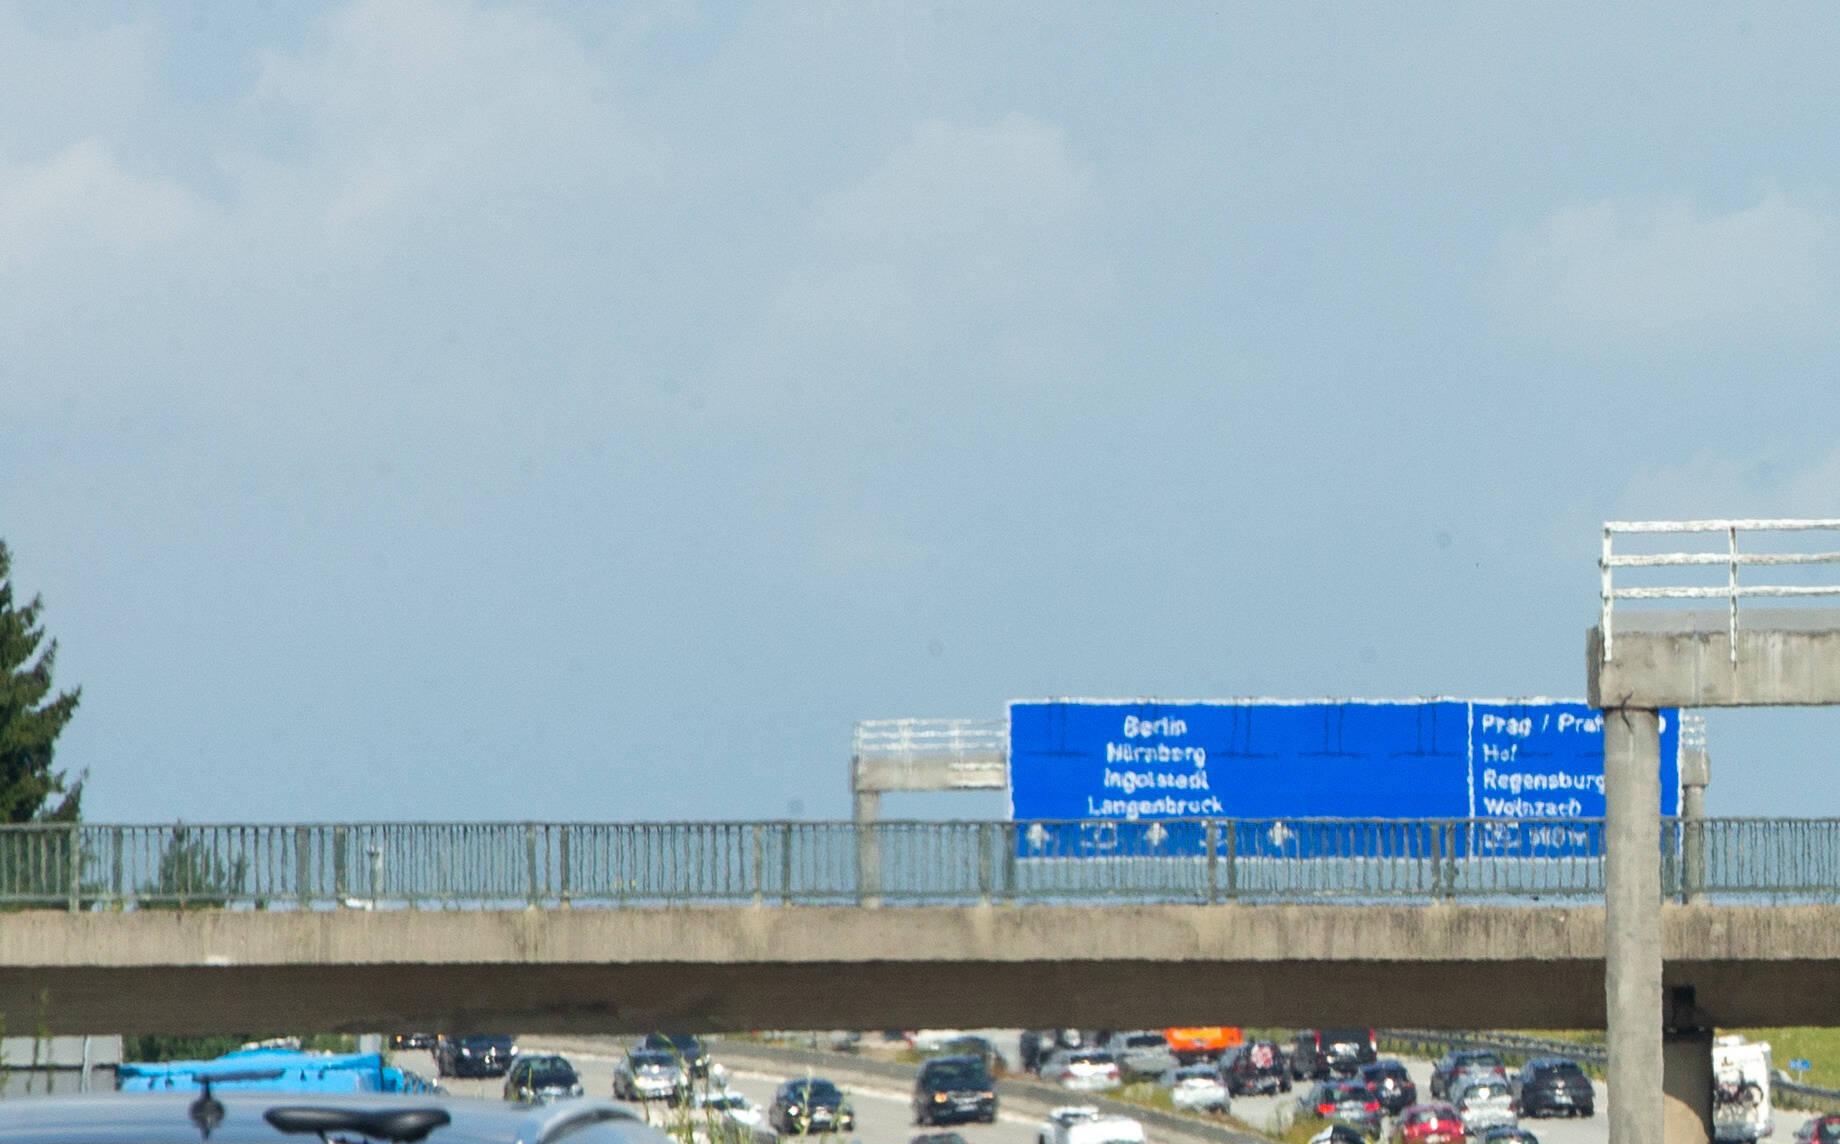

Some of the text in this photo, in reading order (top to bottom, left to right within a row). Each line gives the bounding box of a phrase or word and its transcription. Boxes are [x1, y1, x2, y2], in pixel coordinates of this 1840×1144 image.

[1123, 715, 1188, 737] Berlin
[1483, 713, 1532, 738] Prag
[1106, 742, 1206, 769] Nürnberg
[1483, 744, 1519, 763] Hof
[1103, 768, 1210, 794] Ingolstadt
[1088, 796, 1223, 820] Langenbruck
[1483, 797, 1583, 817] Wolnzach
